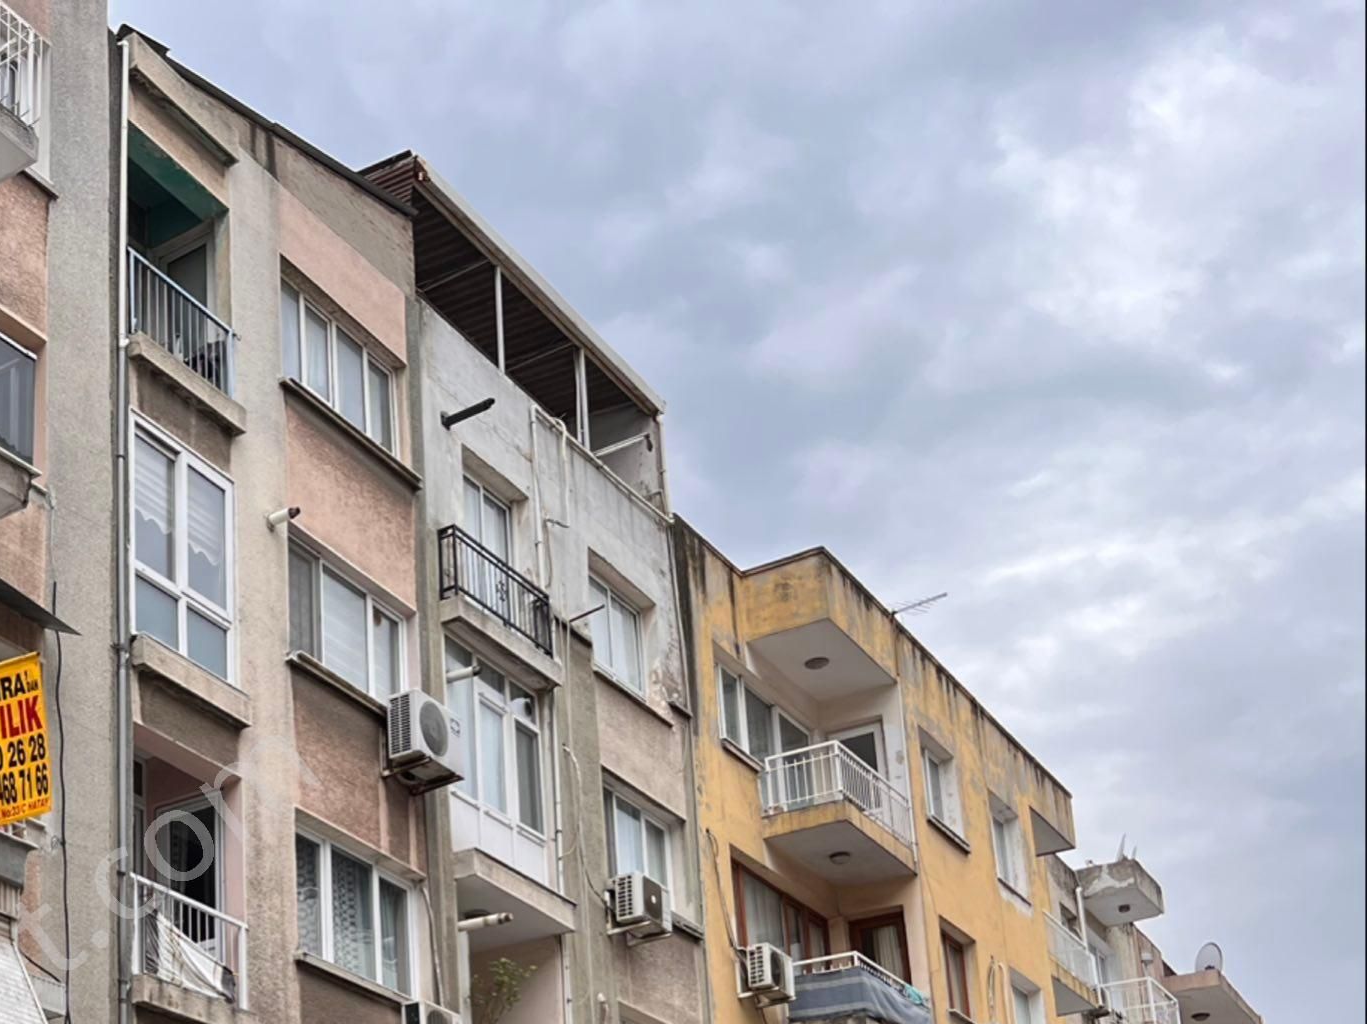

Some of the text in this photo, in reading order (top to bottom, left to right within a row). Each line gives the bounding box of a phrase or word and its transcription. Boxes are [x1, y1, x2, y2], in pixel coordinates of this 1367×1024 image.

[7, 739, 26, 767] 26
[28, 733, 46, 762] 28
[19, 768, 33, 801] 71
[35, 763, 49, 796] 66
